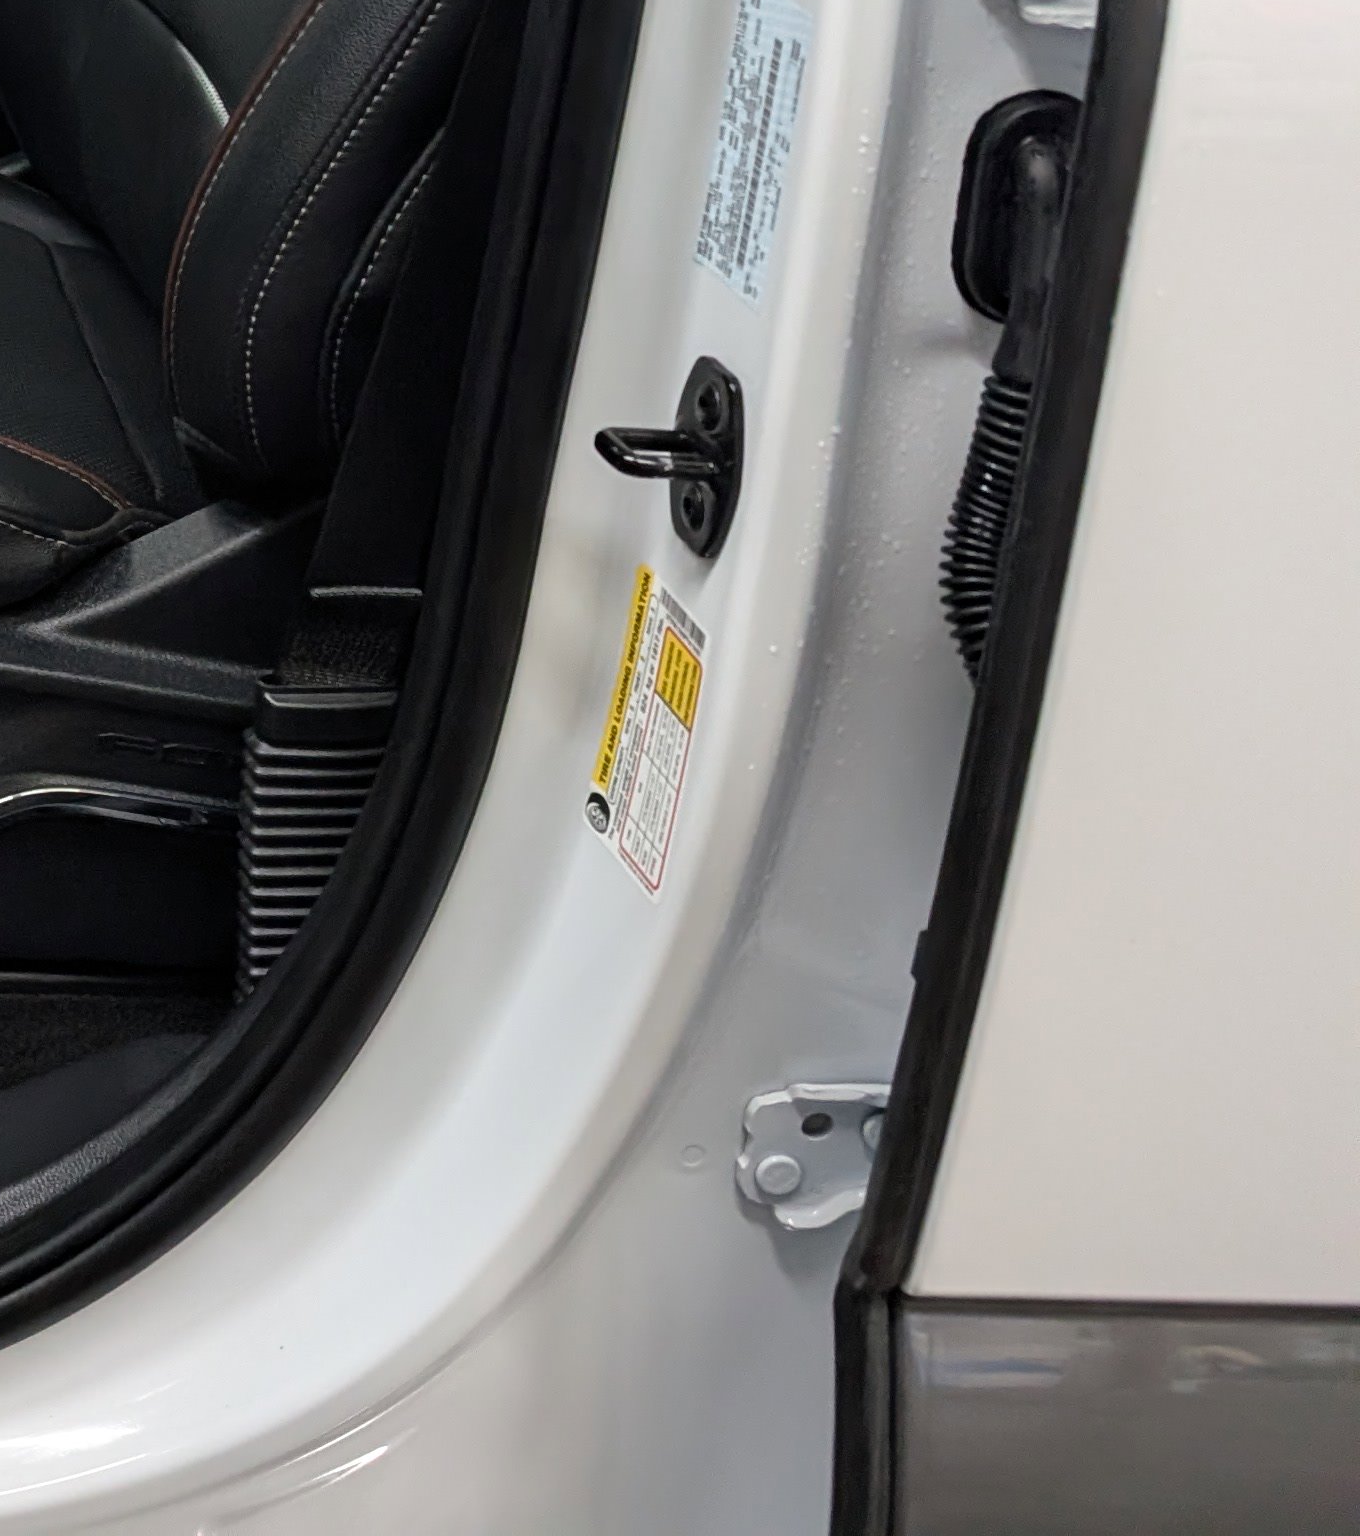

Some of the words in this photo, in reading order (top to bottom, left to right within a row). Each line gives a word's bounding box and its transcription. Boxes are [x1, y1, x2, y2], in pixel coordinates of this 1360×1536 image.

[598, 753, 611, 783] TIRE
[607, 725, 618, 752] AND
[614, 665, 632, 723] LOADING
[627, 572, 651, 663] INFORMATION
